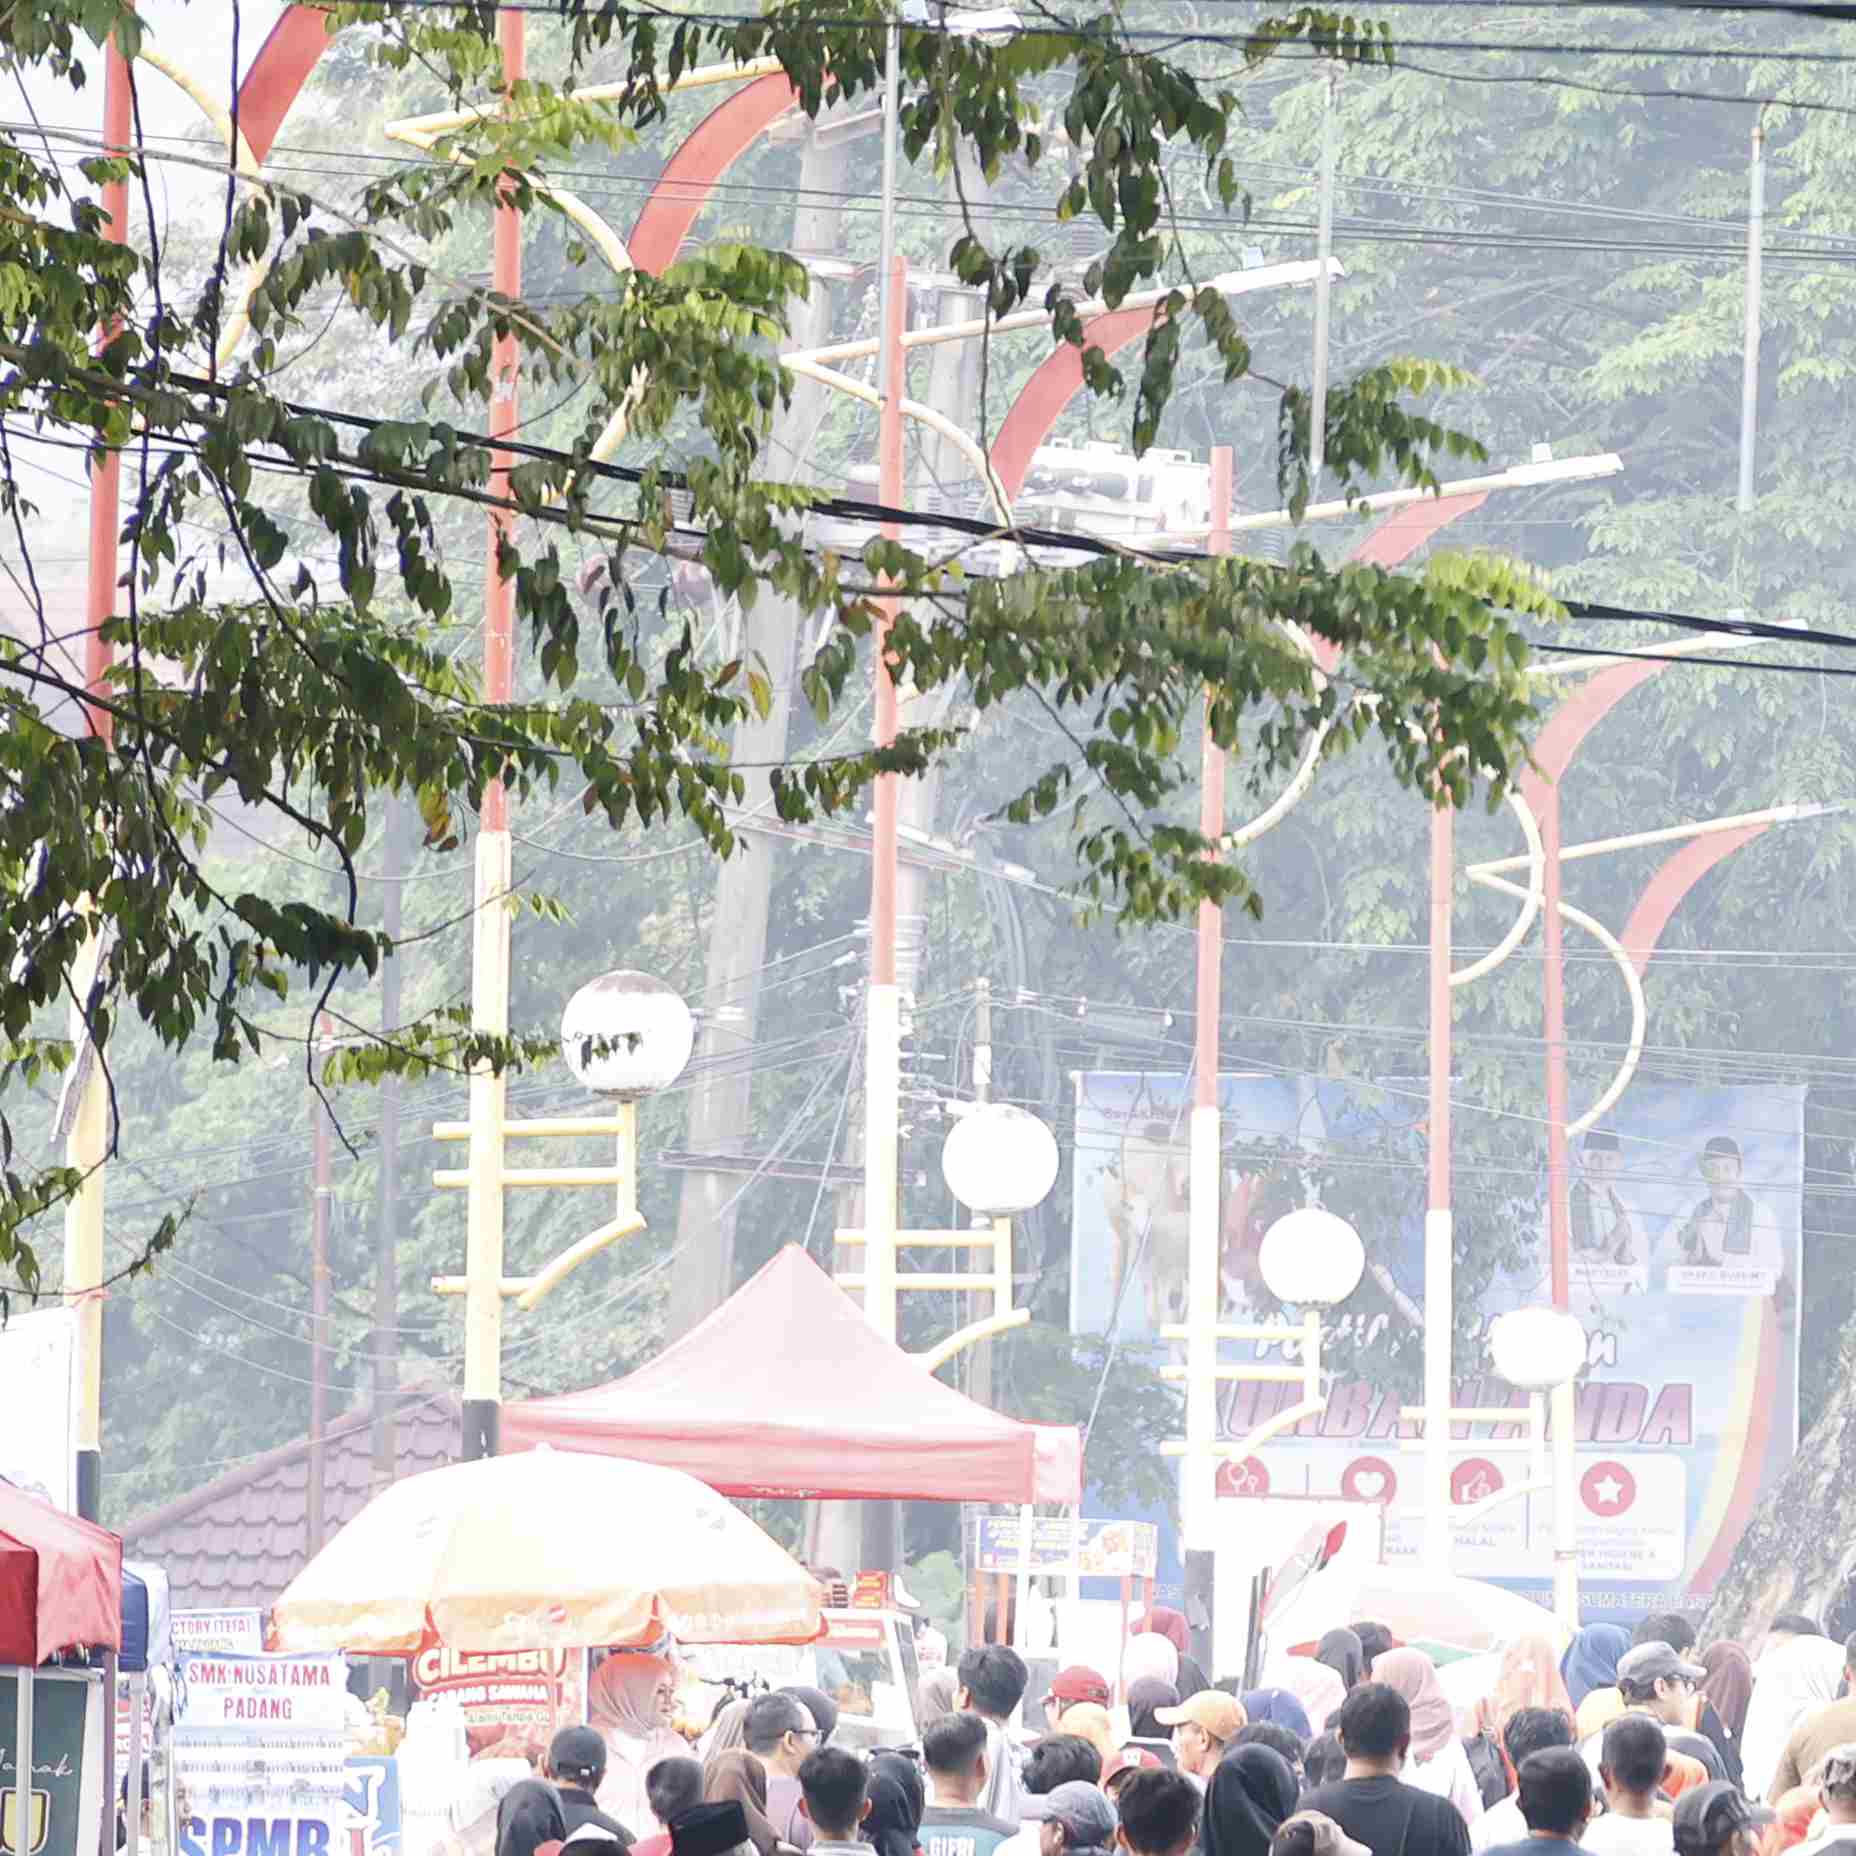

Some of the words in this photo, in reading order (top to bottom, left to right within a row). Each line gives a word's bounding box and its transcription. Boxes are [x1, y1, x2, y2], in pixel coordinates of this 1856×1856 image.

[190, 1663, 226, 1684] SMK
[233, 1664, 331, 1686] NUSATAMA
[224, 1697, 293, 1719] PADANG
